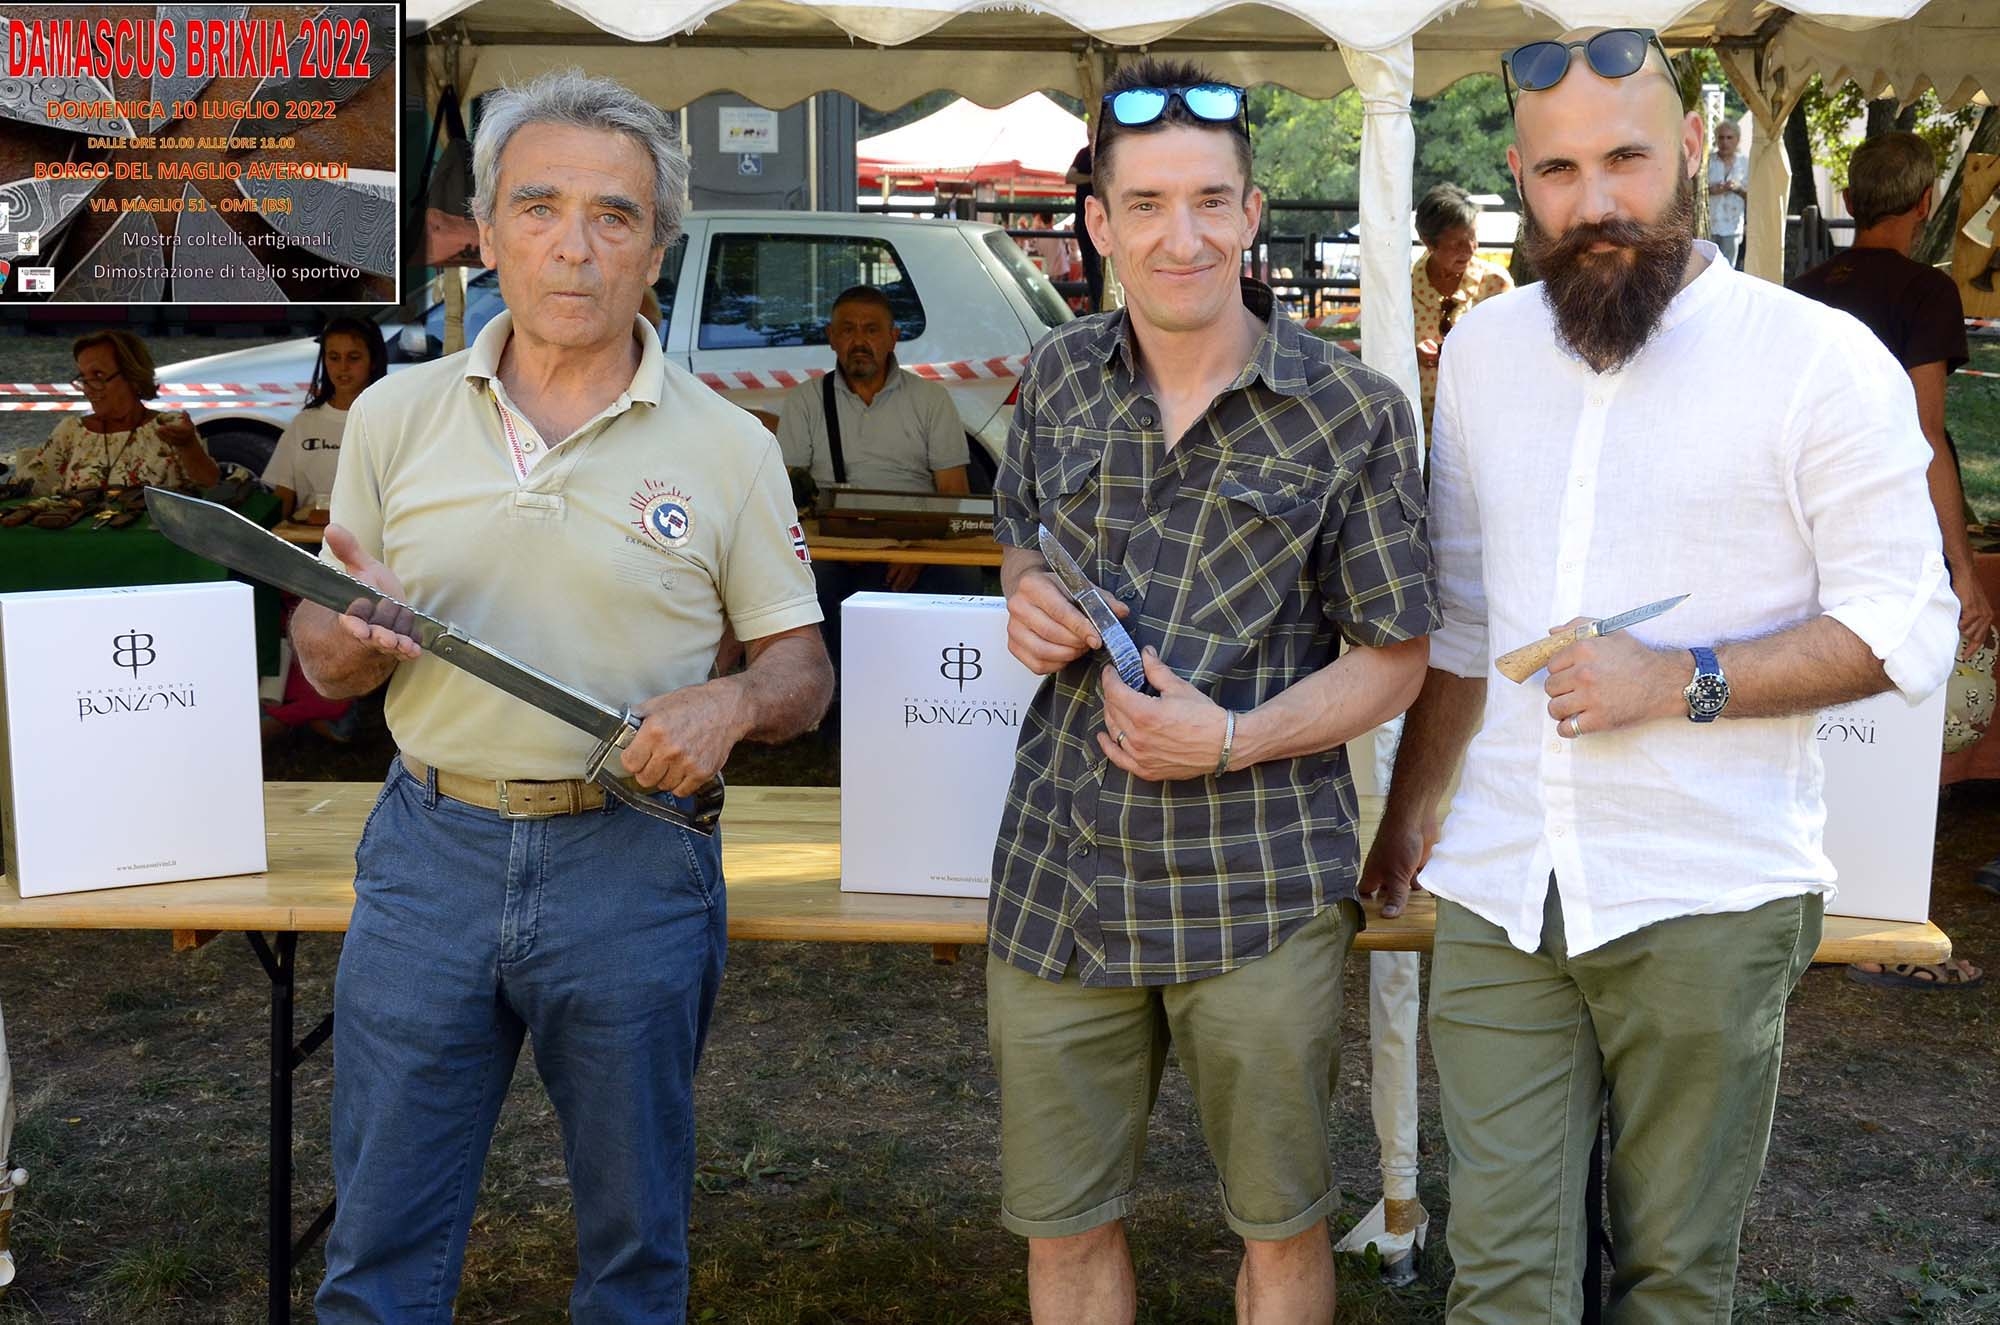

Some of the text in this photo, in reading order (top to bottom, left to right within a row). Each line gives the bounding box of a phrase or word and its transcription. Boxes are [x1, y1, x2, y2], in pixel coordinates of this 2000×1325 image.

[301, 438, 340, 450] Cha
[77, 689, 197, 723] BONZONI
[904, 704, 1020, 728] BONZONI
[1816, 722, 1877, 744] ZONI
